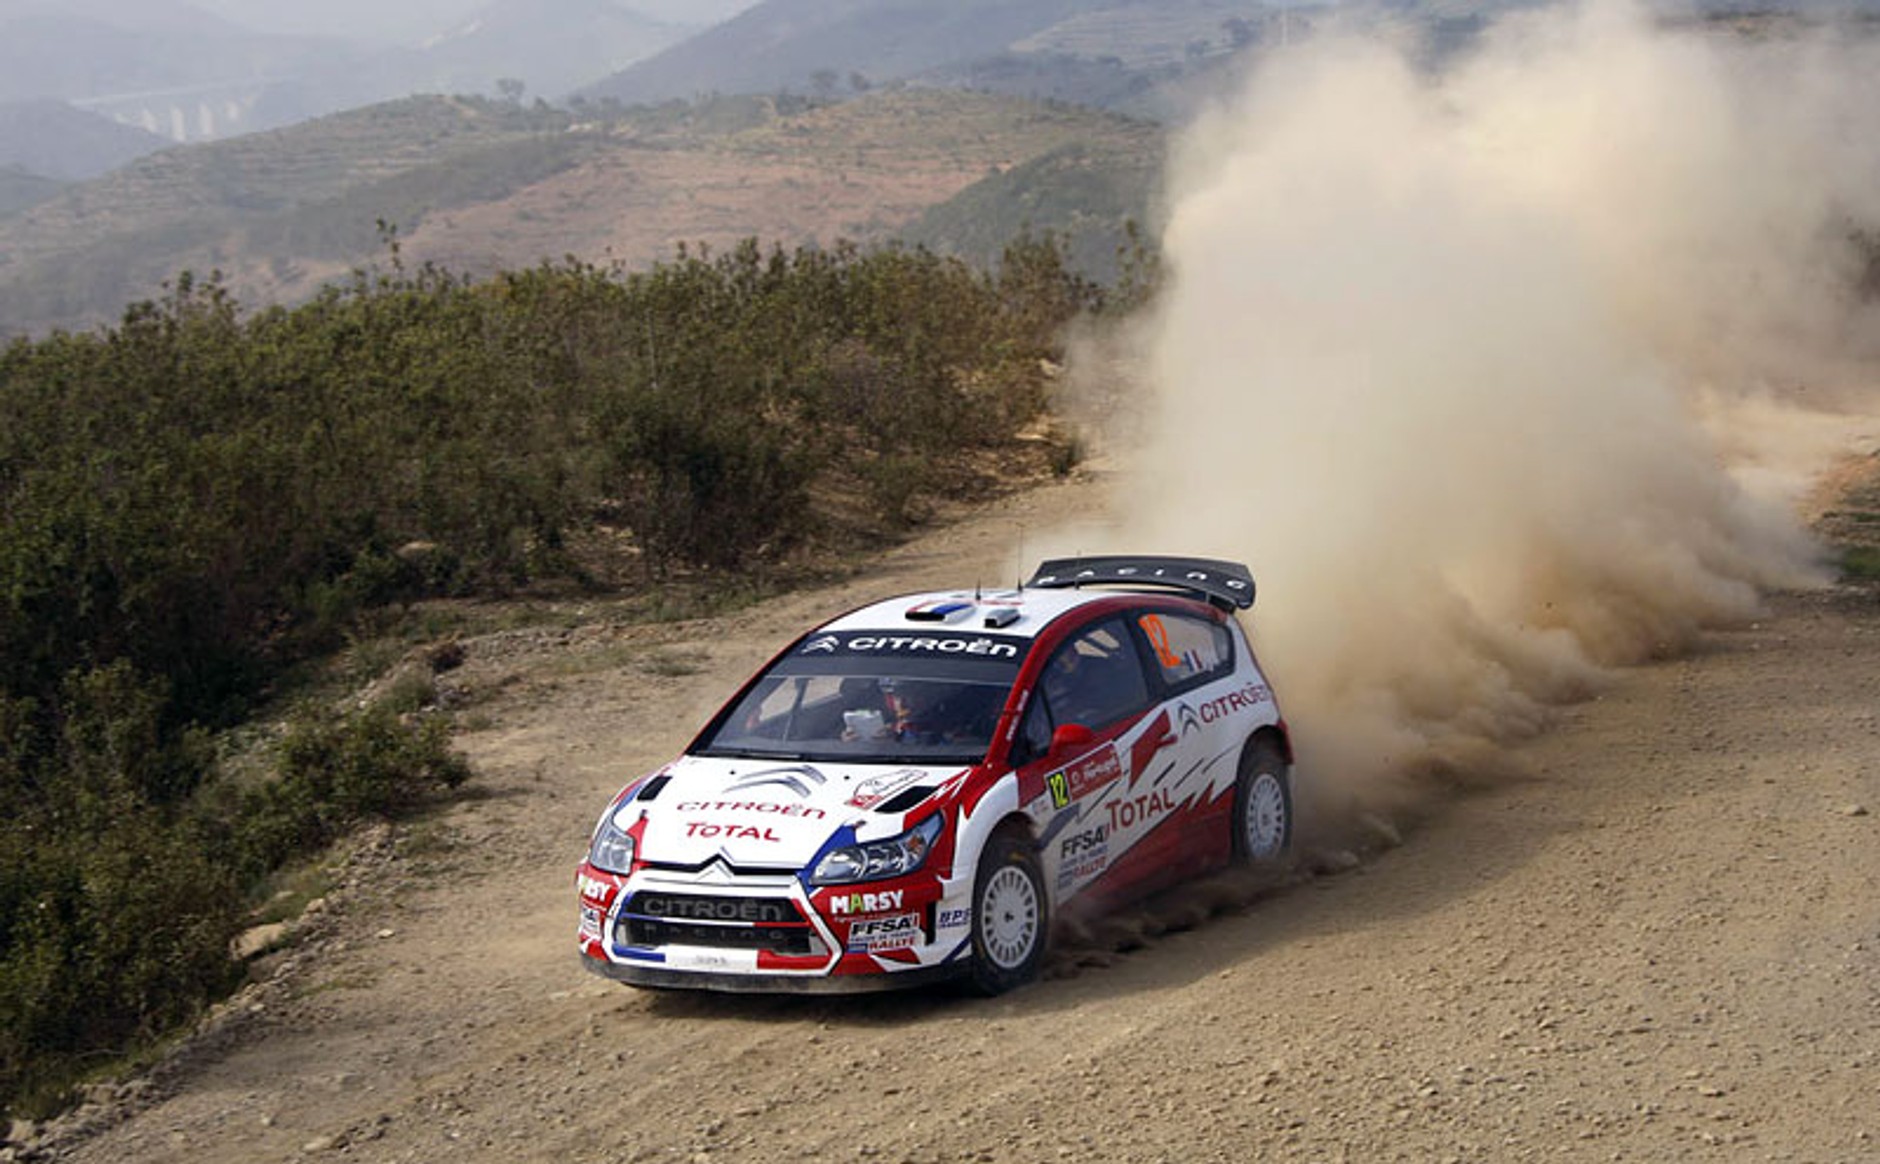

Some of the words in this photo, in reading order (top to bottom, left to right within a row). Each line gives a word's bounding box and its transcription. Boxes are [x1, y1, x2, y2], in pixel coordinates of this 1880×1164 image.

[1138, 613, 1181, 668] 12
[1050, 773, 1069, 808] 12
[1105, 788, 1176, 832] TOTAL
[685, 822, 782, 842] TOTAL
[1061, 824, 1105, 859] FFSA
[830, 889, 904, 914] MARSY
[852, 916, 913, 935] FFSA
